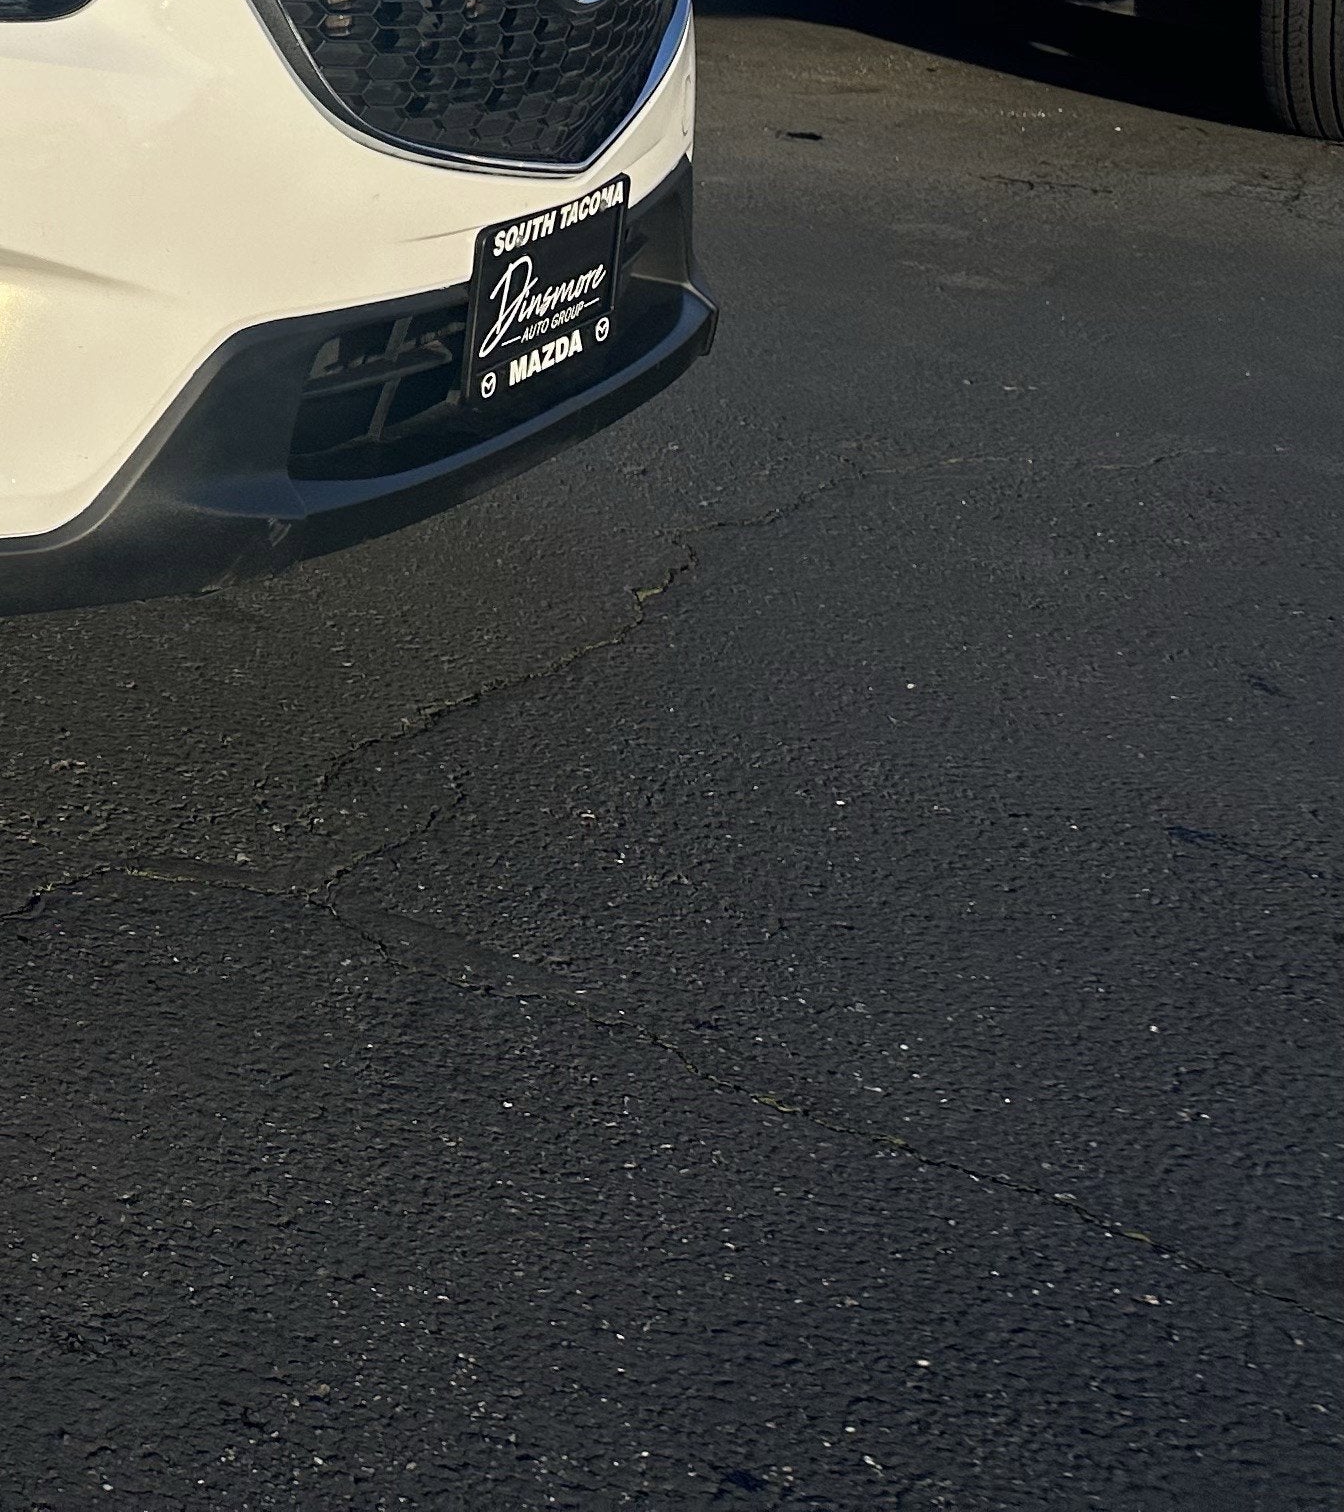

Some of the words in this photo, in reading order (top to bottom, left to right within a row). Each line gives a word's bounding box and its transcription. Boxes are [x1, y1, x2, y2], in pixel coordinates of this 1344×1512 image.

[492, 210, 556, 257] SOUTH
[560, 181, 624, 230] TACOMA
[478, 255, 607, 358] Dinsmore
[520, 319, 549, 343] AUTO
[550, 300, 585, 330] GROUP
[508, 329, 583, 386] MAZDA
